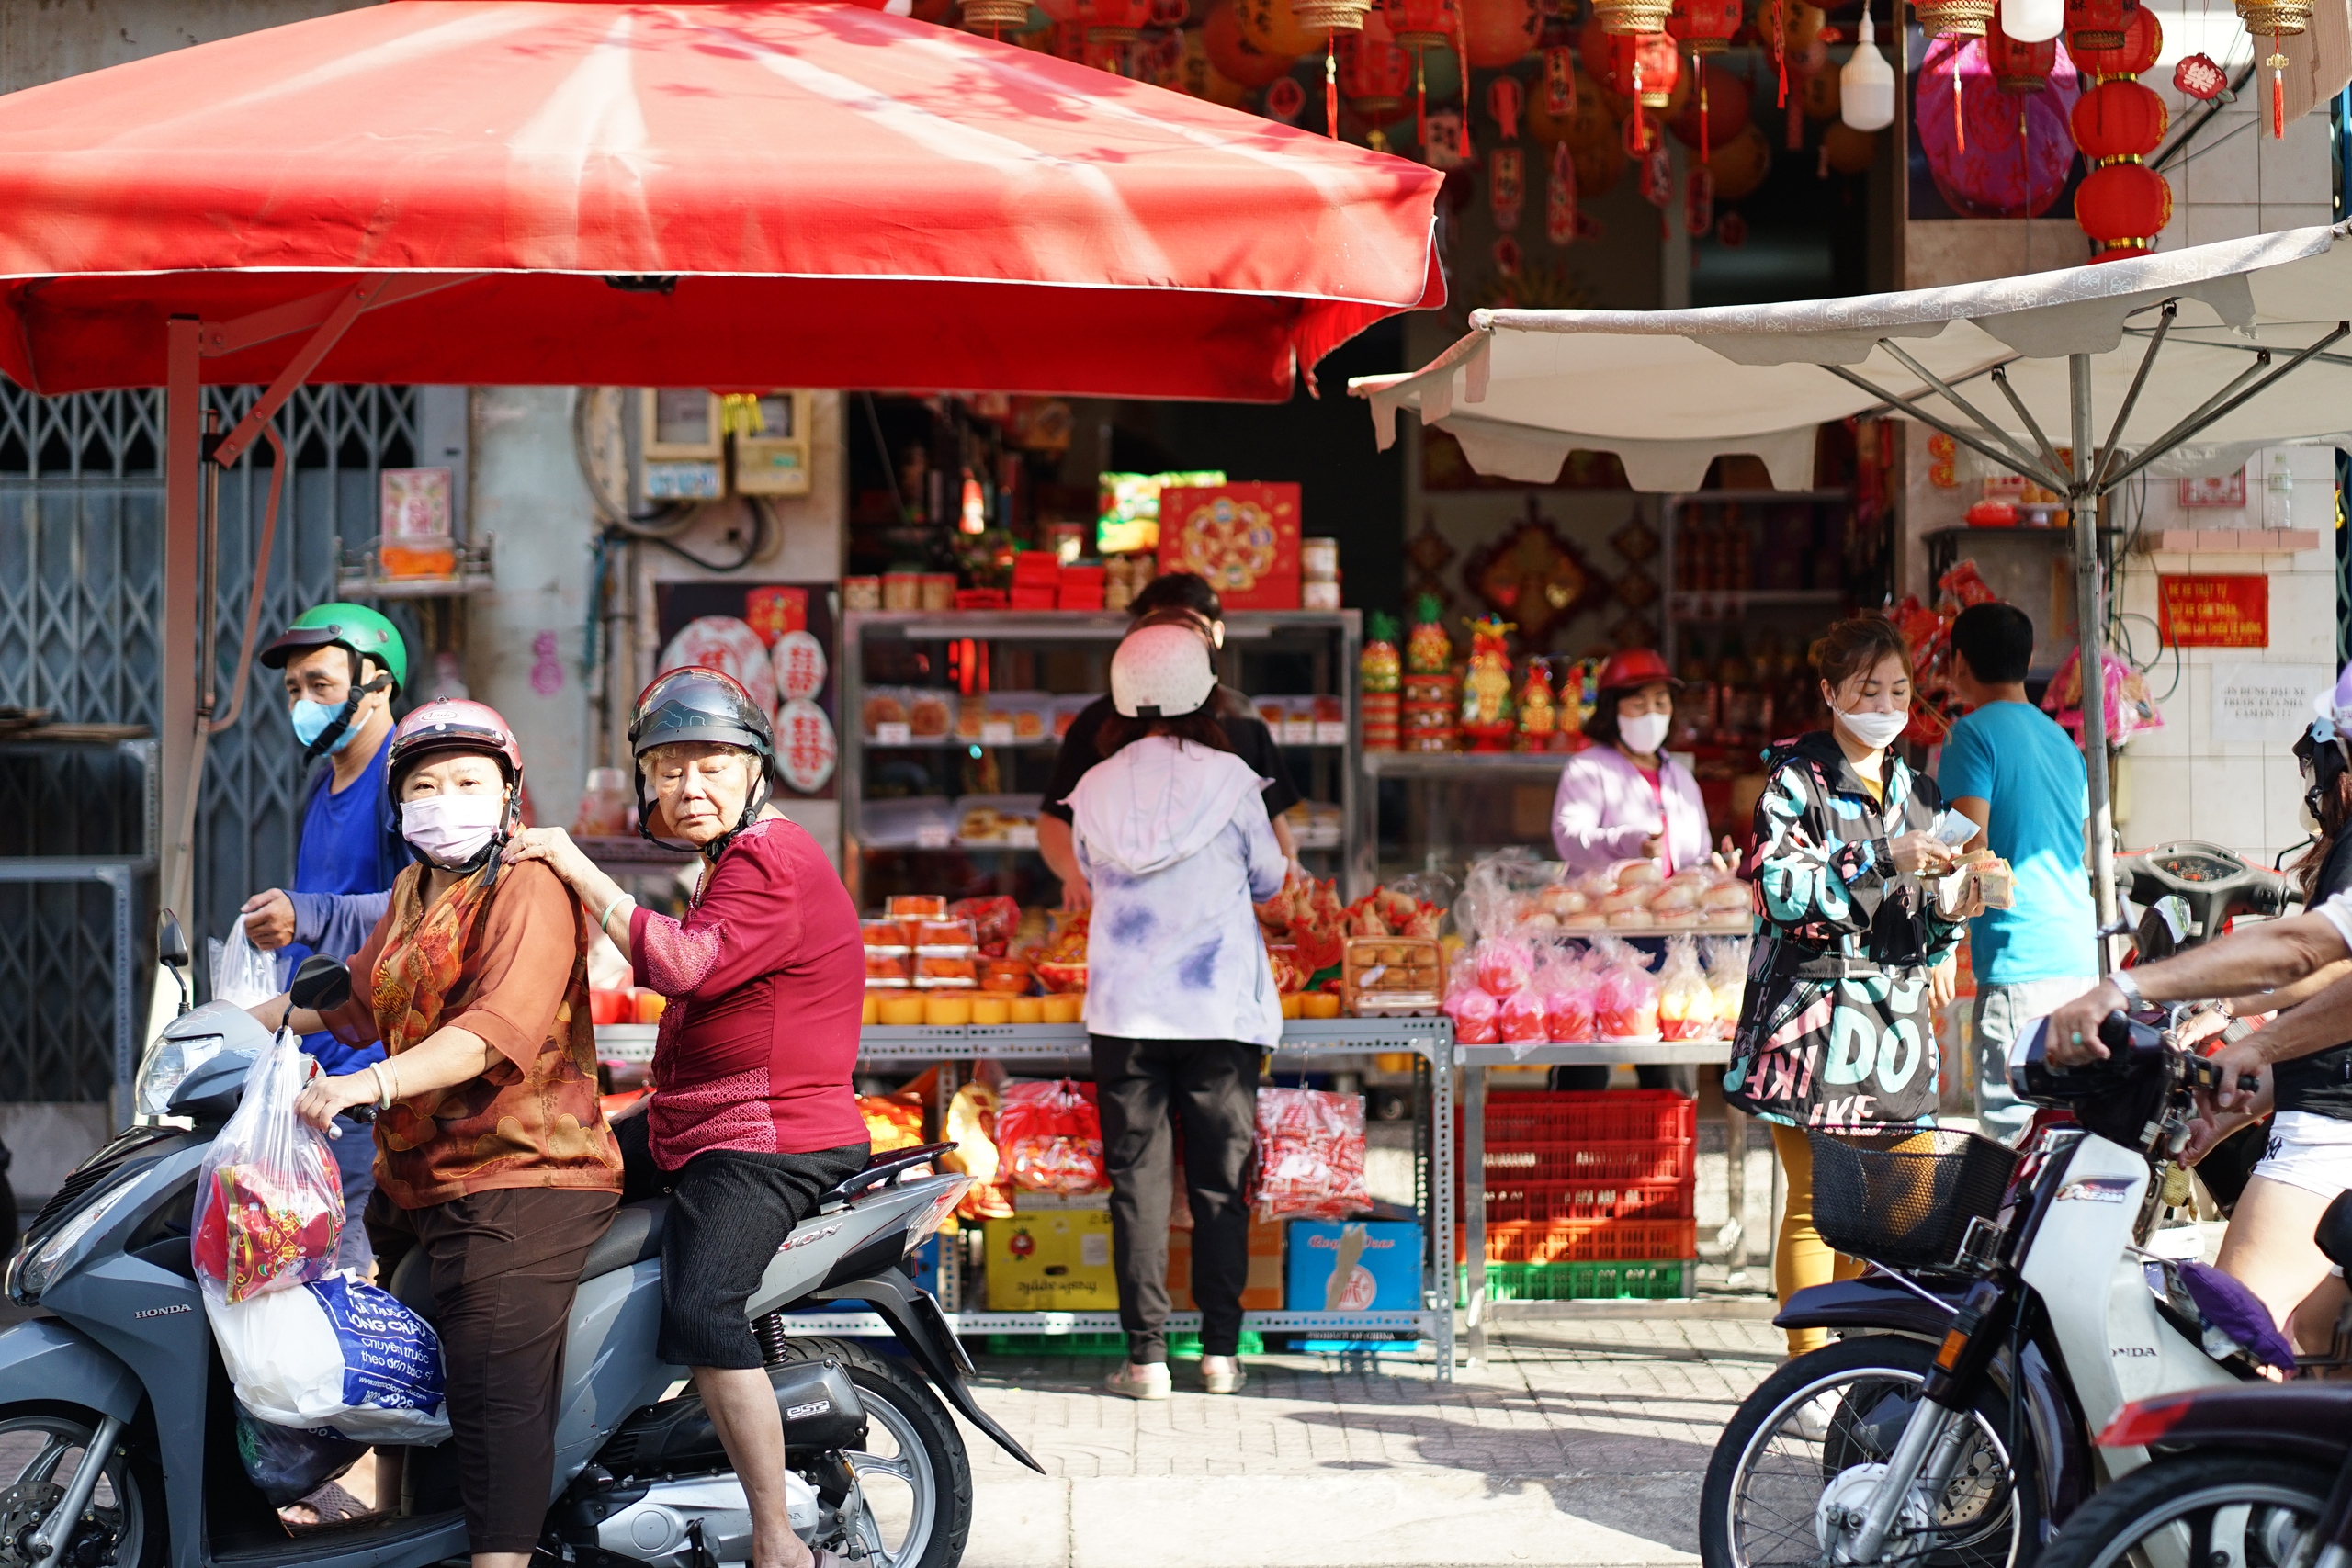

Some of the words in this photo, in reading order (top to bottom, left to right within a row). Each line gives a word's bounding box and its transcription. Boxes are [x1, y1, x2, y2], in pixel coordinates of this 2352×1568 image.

[1824, 1005, 1922, 1094] DO
[135, 1303, 193, 1320] HONDA
[361, 1350, 386, 1366] theo
